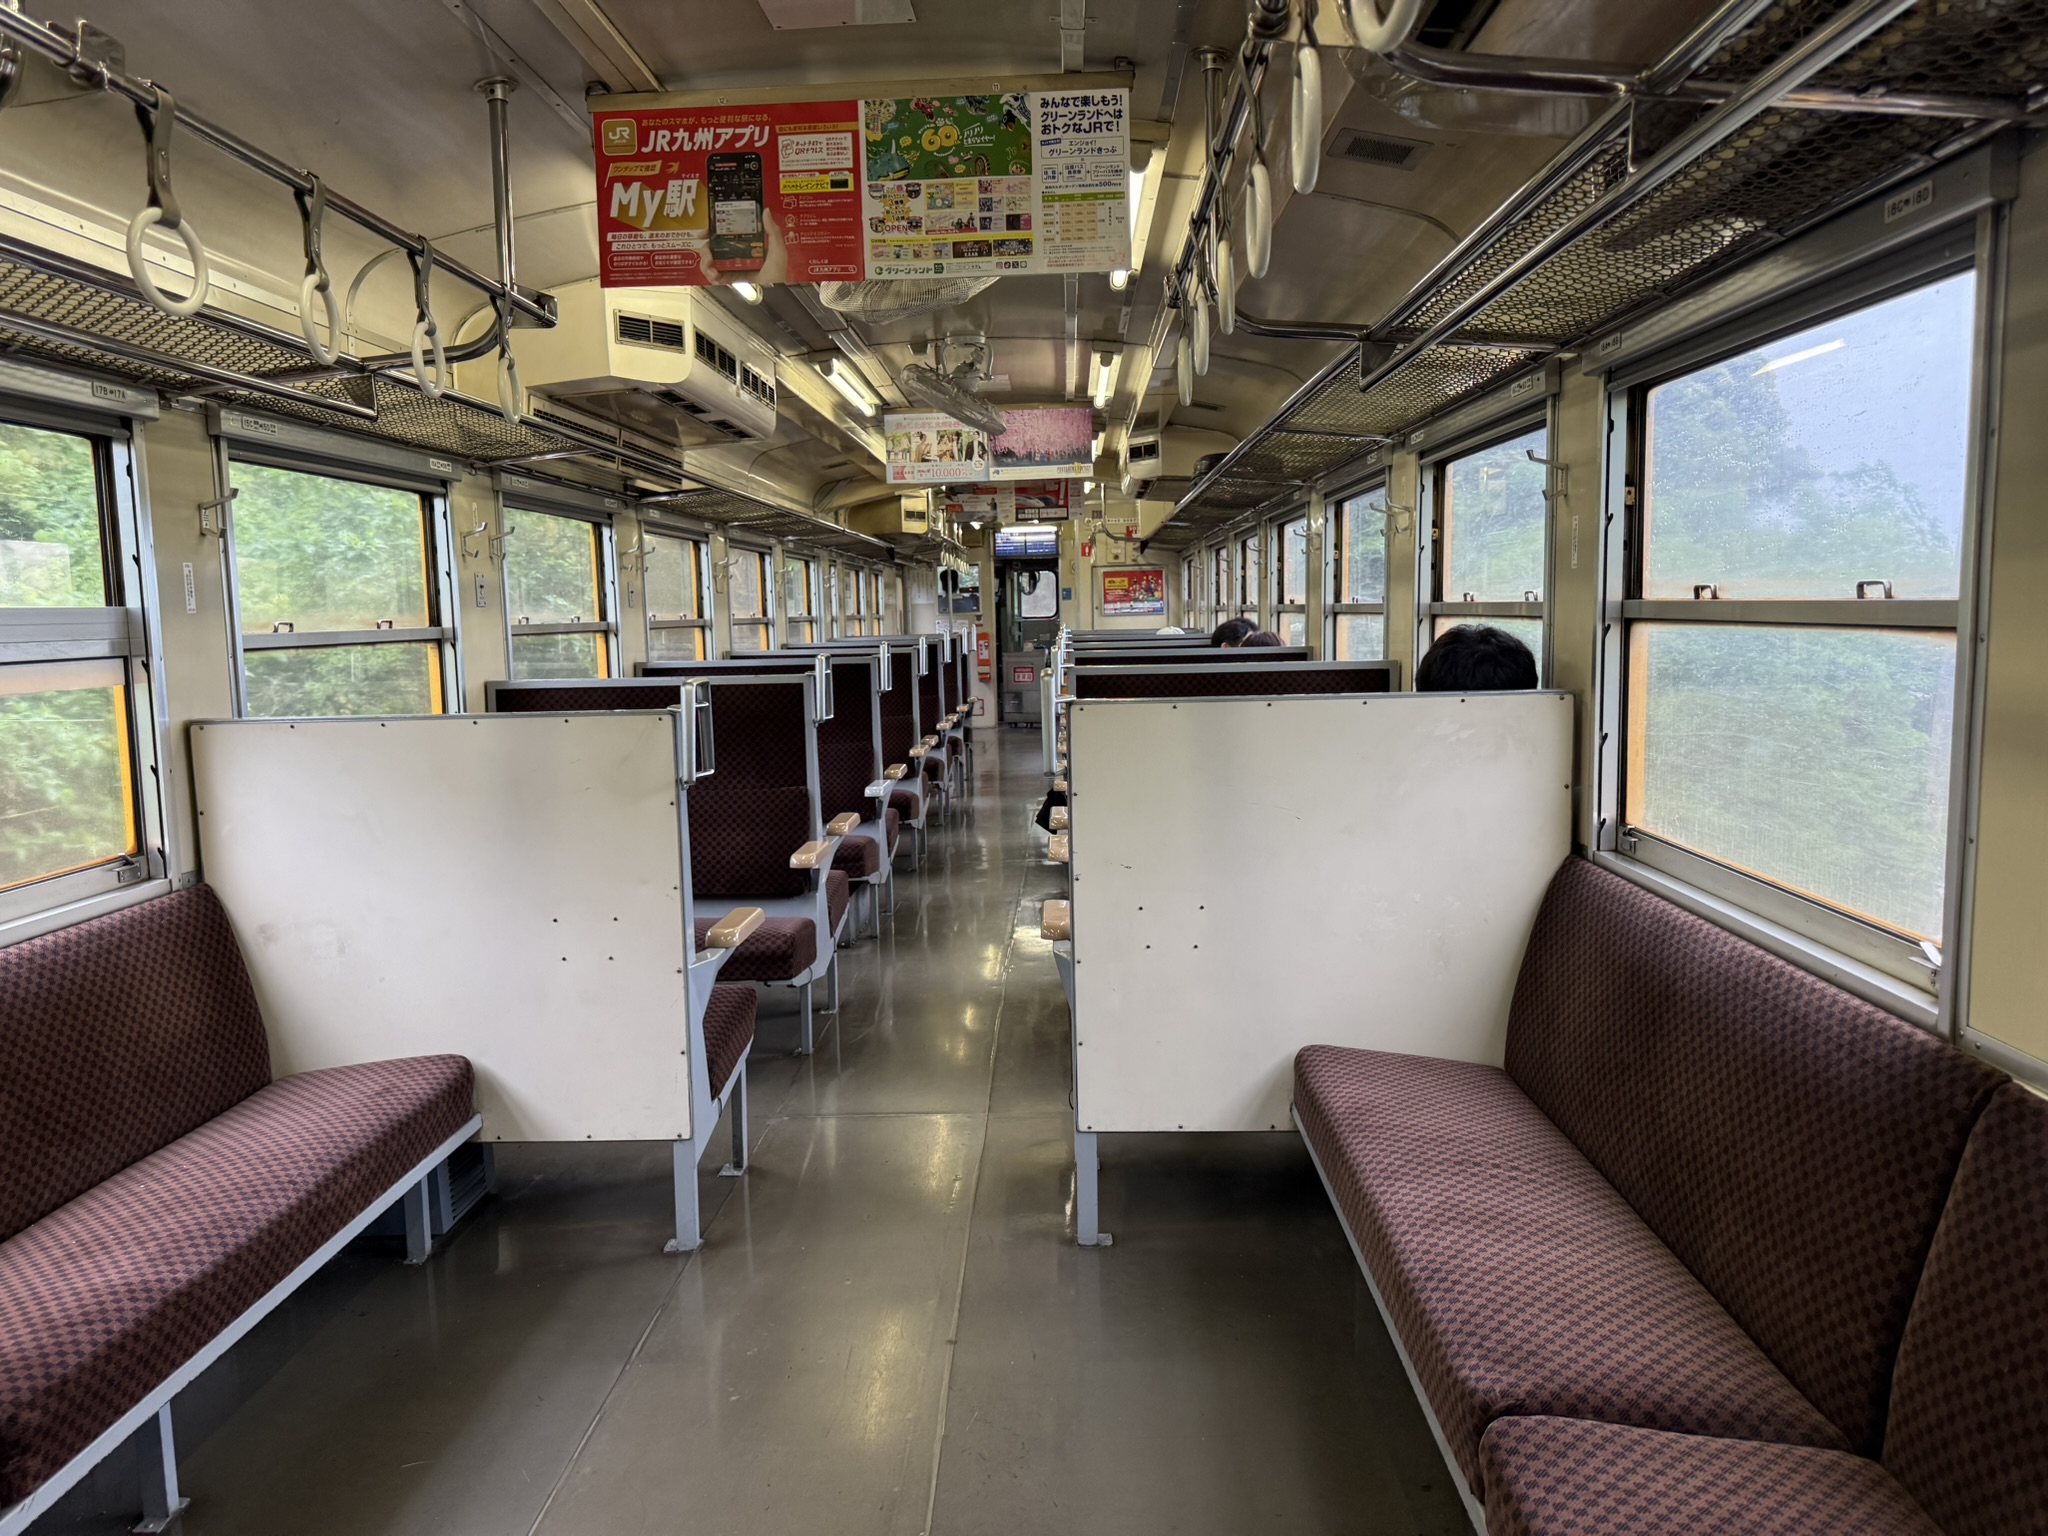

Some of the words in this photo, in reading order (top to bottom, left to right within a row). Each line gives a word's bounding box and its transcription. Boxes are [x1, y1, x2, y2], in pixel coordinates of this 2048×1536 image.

[1040, 95, 1122, 108] みんなで楽しもう!
[1041, 109, 1123, 122] グリーンランドへは
[609, 127, 630, 139] JR
[1041, 121, 1120, 135] おトクなJRで!
[641, 125, 770, 153] JR九州アプリ
[921, 125, 958, 151] 60
[1049, 146, 1117, 156] グリーンランドきっぷ
[610, 179, 699, 227] My駅
[884, 224, 908, 232] OPEN
